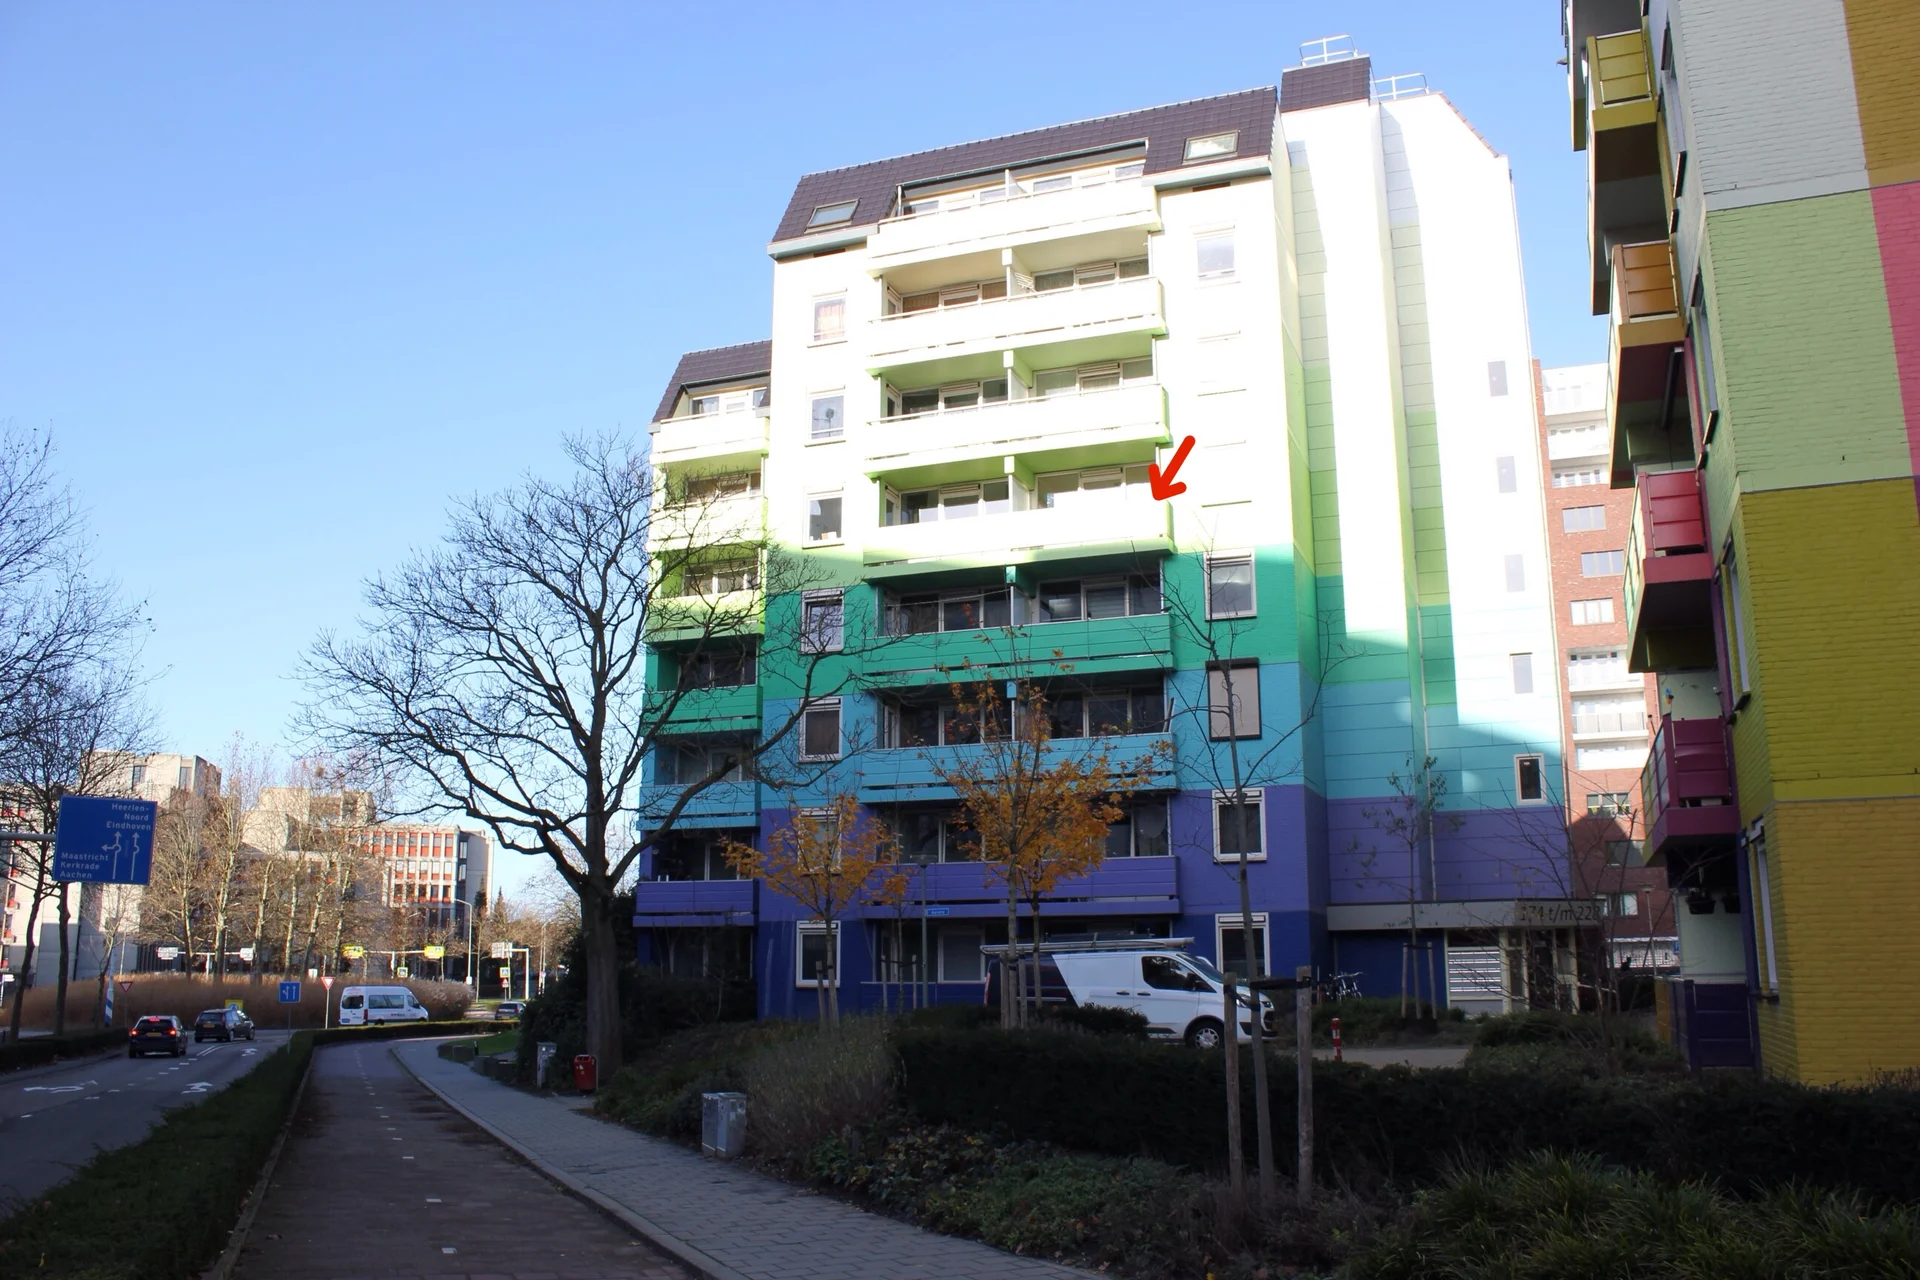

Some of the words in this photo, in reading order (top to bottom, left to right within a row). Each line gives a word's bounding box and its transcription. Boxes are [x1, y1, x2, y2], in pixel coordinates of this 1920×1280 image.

[112, 803, 149, 811] Heerlen-
[124, 813, 149, 821] Noord
[106, 821, 151, 830] Eindhoven
[61, 852, 109, 861] Maastricht
[60, 862, 100, 870] Kerkrade
[60, 871, 92, 879] Aachen
[1548, 904, 1572, 923] t/m
